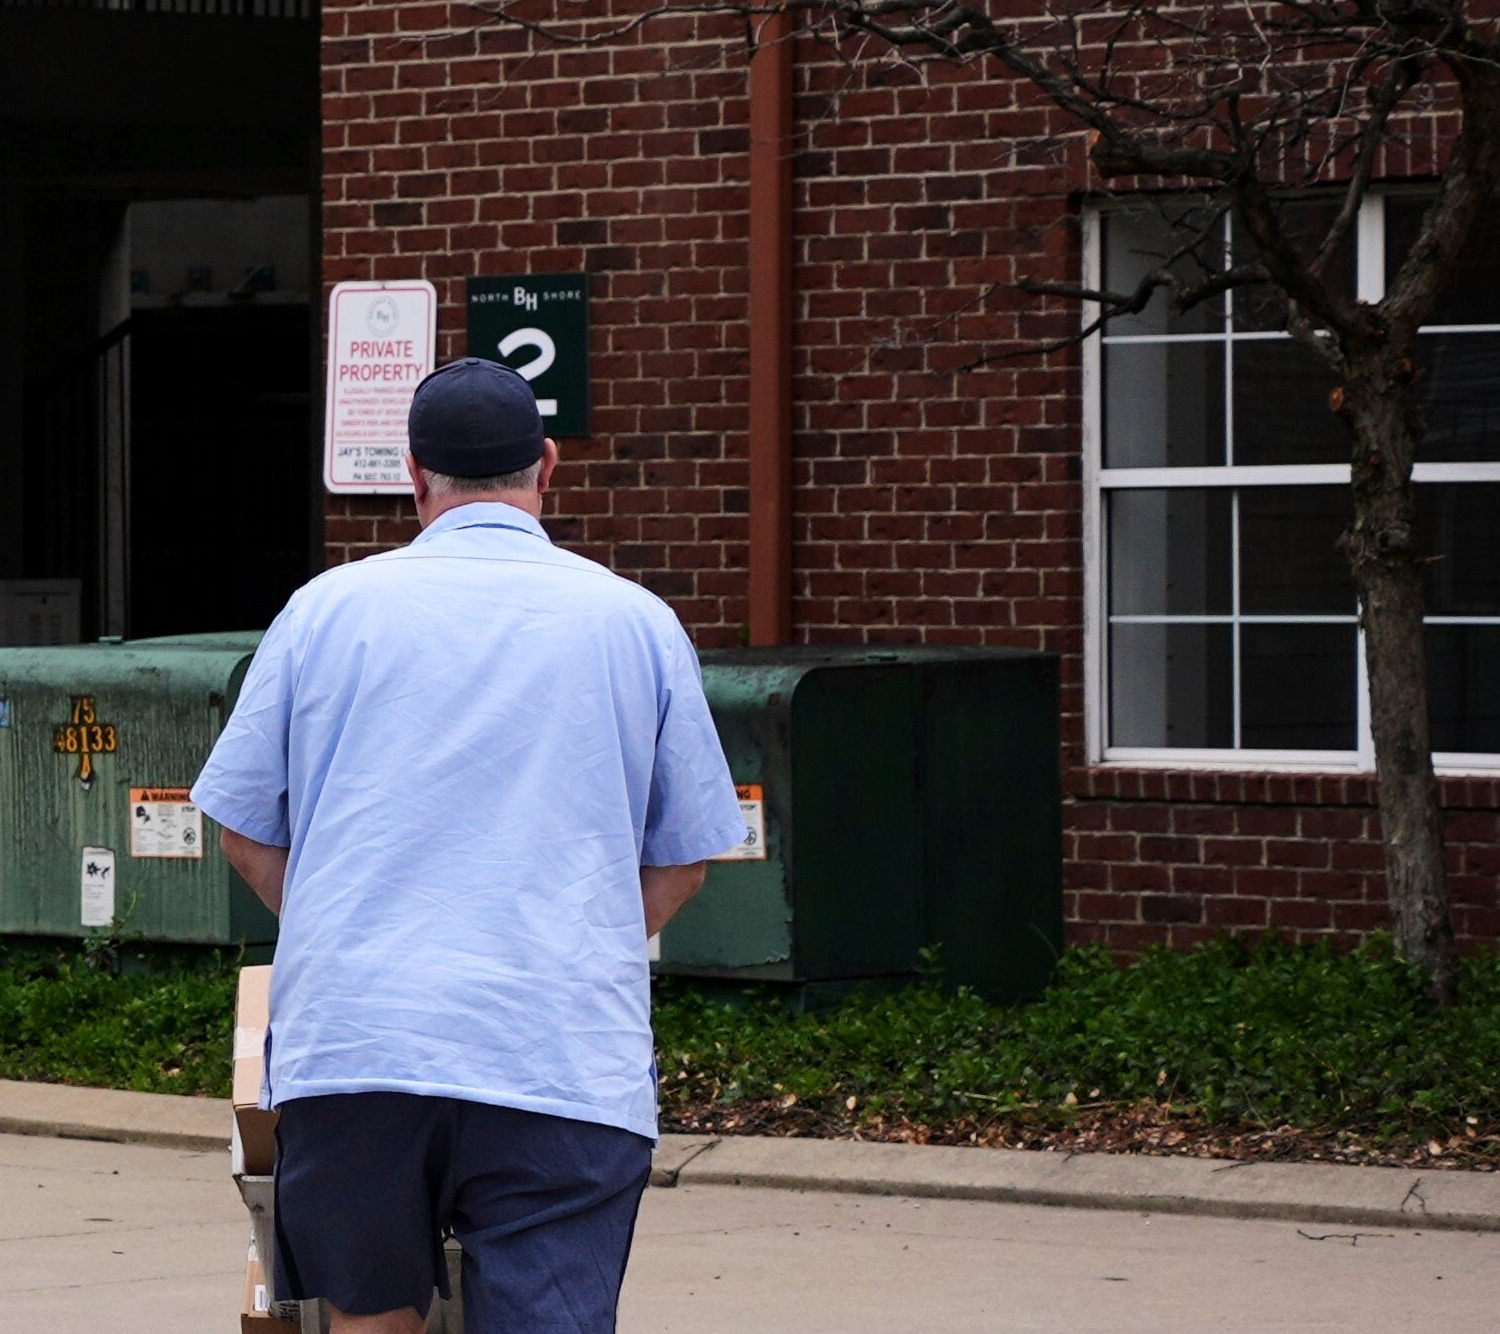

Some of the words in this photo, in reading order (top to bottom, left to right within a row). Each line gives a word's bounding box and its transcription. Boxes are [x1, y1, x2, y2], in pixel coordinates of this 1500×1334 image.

[350, 340, 413, 358] PRIVATE
[339, 363, 423, 381] PROPERTY
[497, 327, 558, 417] 2
[151, 791, 191, 802] WARNIN
